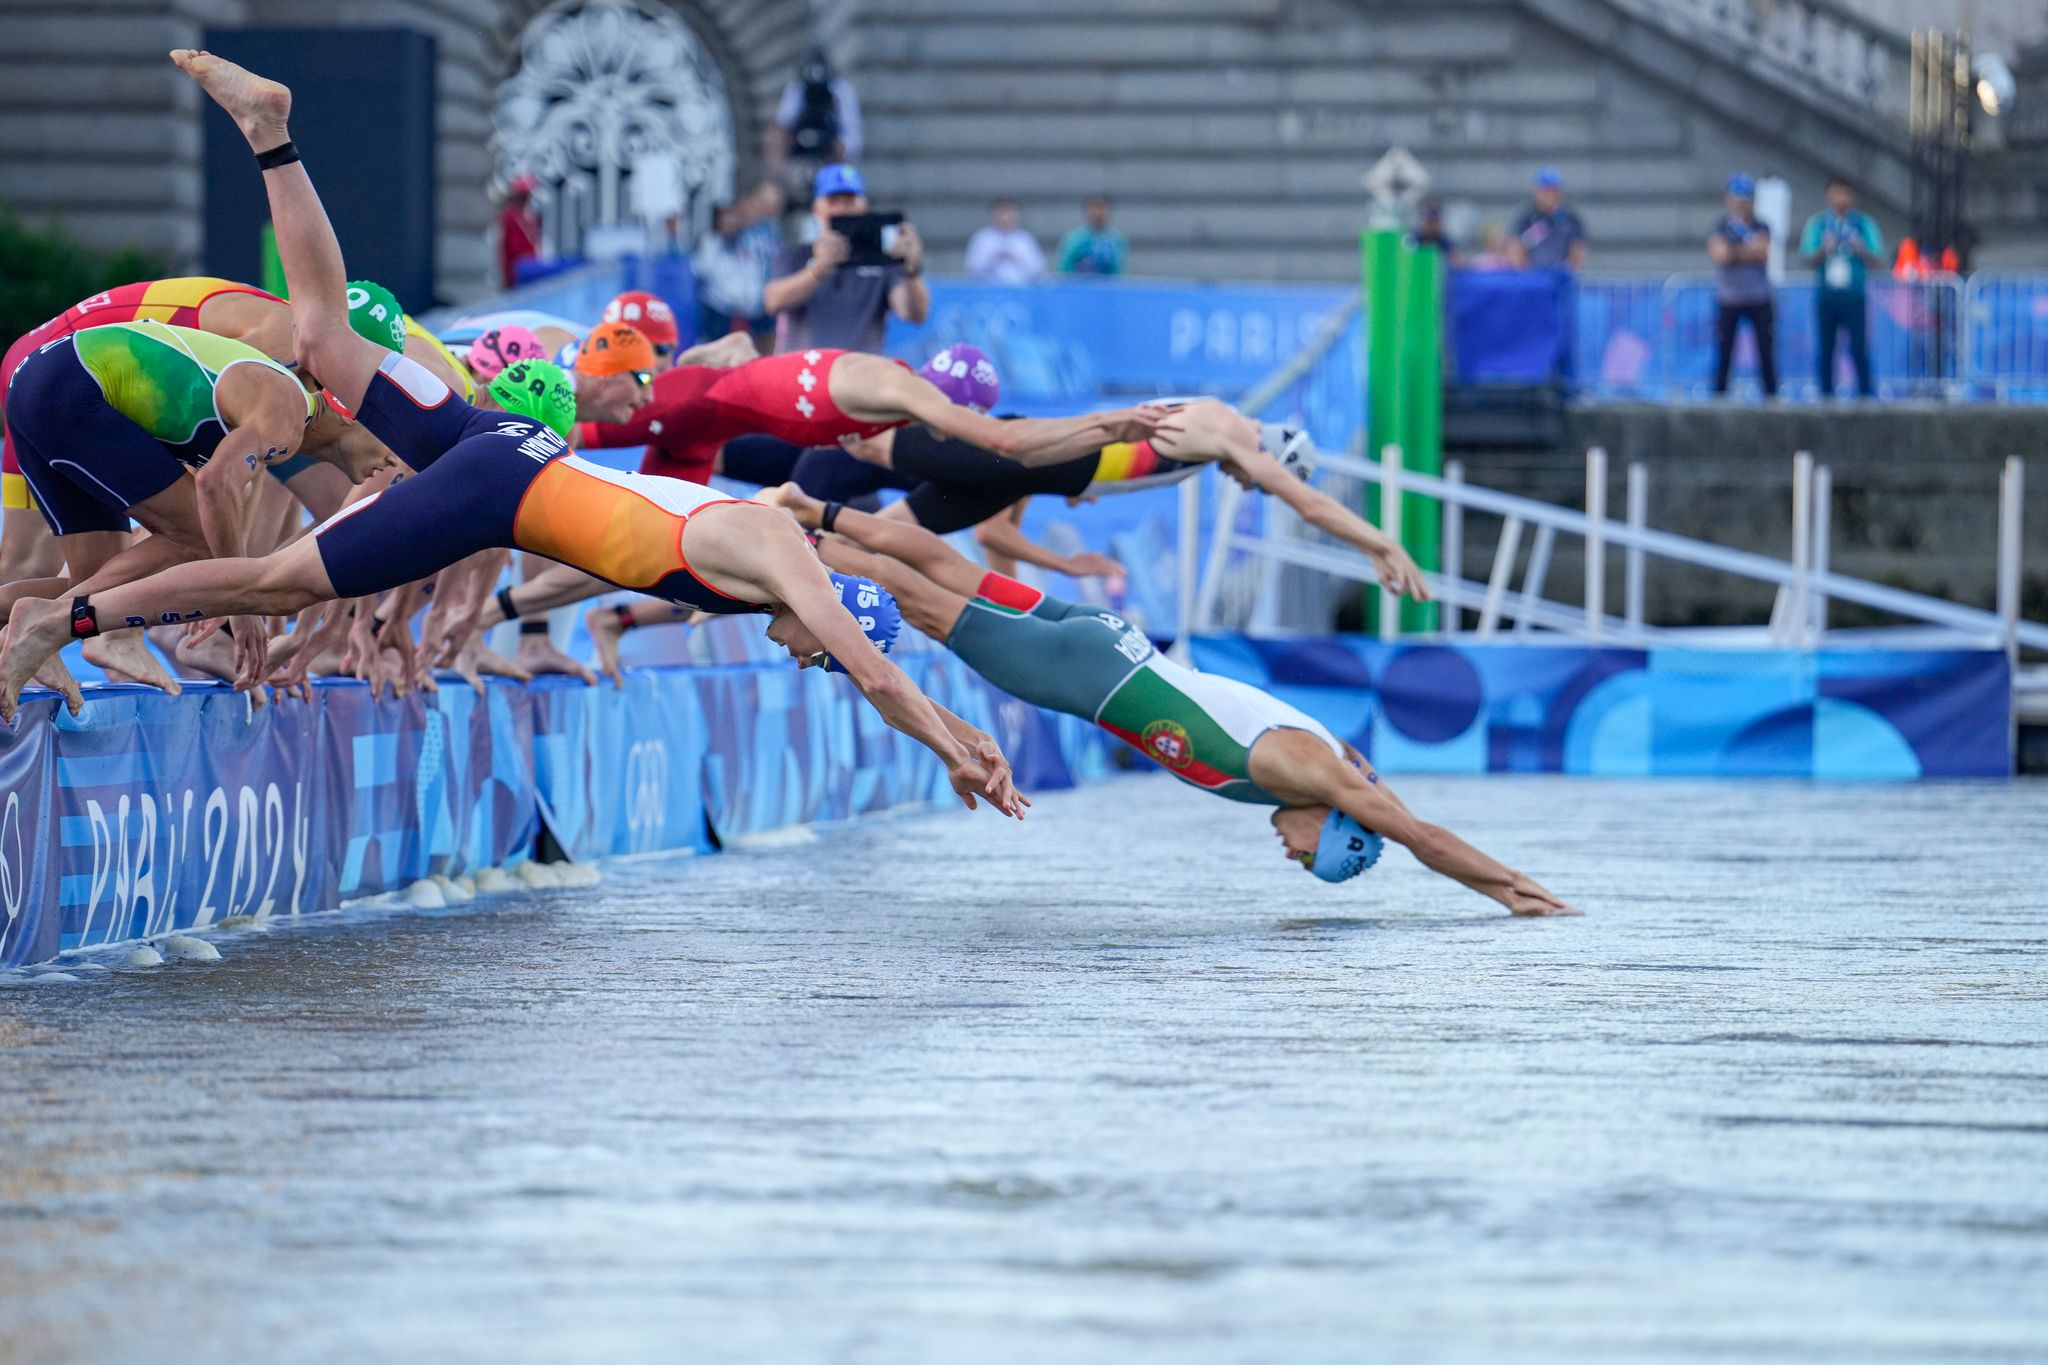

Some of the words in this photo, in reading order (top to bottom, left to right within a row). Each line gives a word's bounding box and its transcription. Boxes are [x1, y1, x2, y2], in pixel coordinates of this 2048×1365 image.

[508, 363, 531, 383] 5
[528, 378, 546, 397] A
[857, 584, 880, 609] 15
[858, 615, 876, 632] A
[192, 781, 308, 929] 2024
